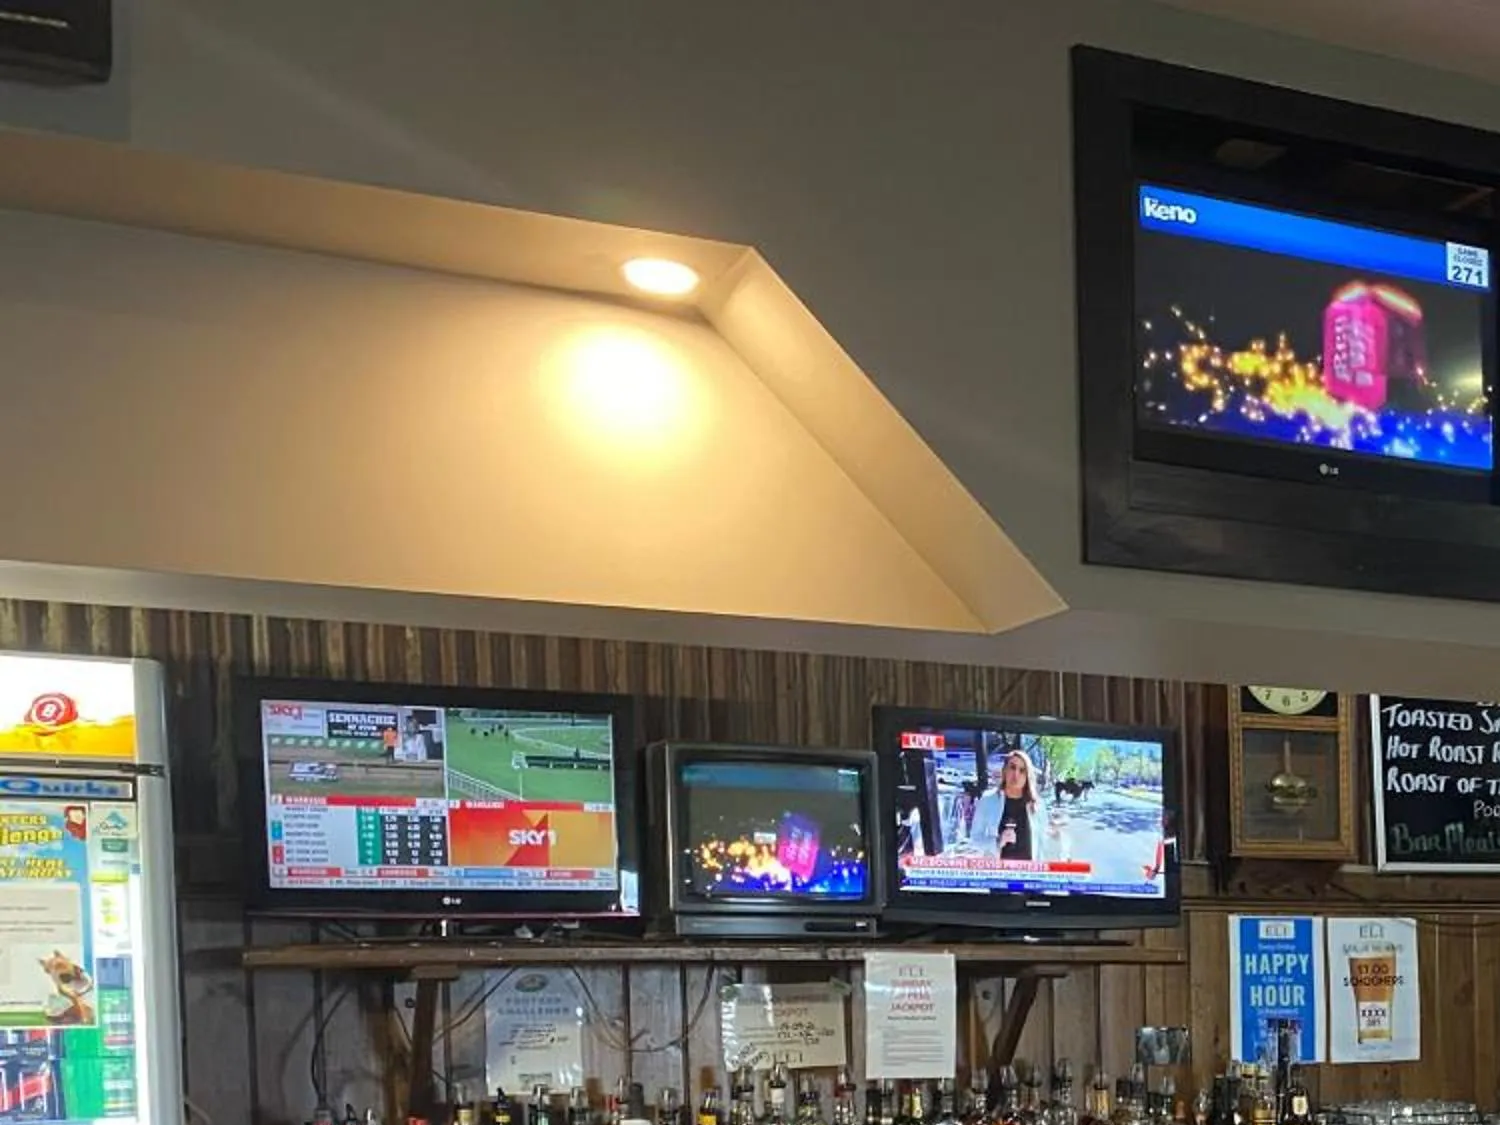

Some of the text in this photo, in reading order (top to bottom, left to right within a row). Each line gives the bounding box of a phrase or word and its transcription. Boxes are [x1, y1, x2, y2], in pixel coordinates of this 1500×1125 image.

[1451, 265, 1483, 285] 271
[1381, 703, 1474, 731] TOASTED
[907, 732, 938, 749] LIVE
[1386, 735, 1422, 761] HOT
[1429, 735, 1486, 765] ROAST
[1386, 766, 1451, 793] ROAST
[1456, 777, 1483, 794] OF
[1244, 953, 1310, 976] HAPPY
[1249, 984, 1307, 1007] HOUR
